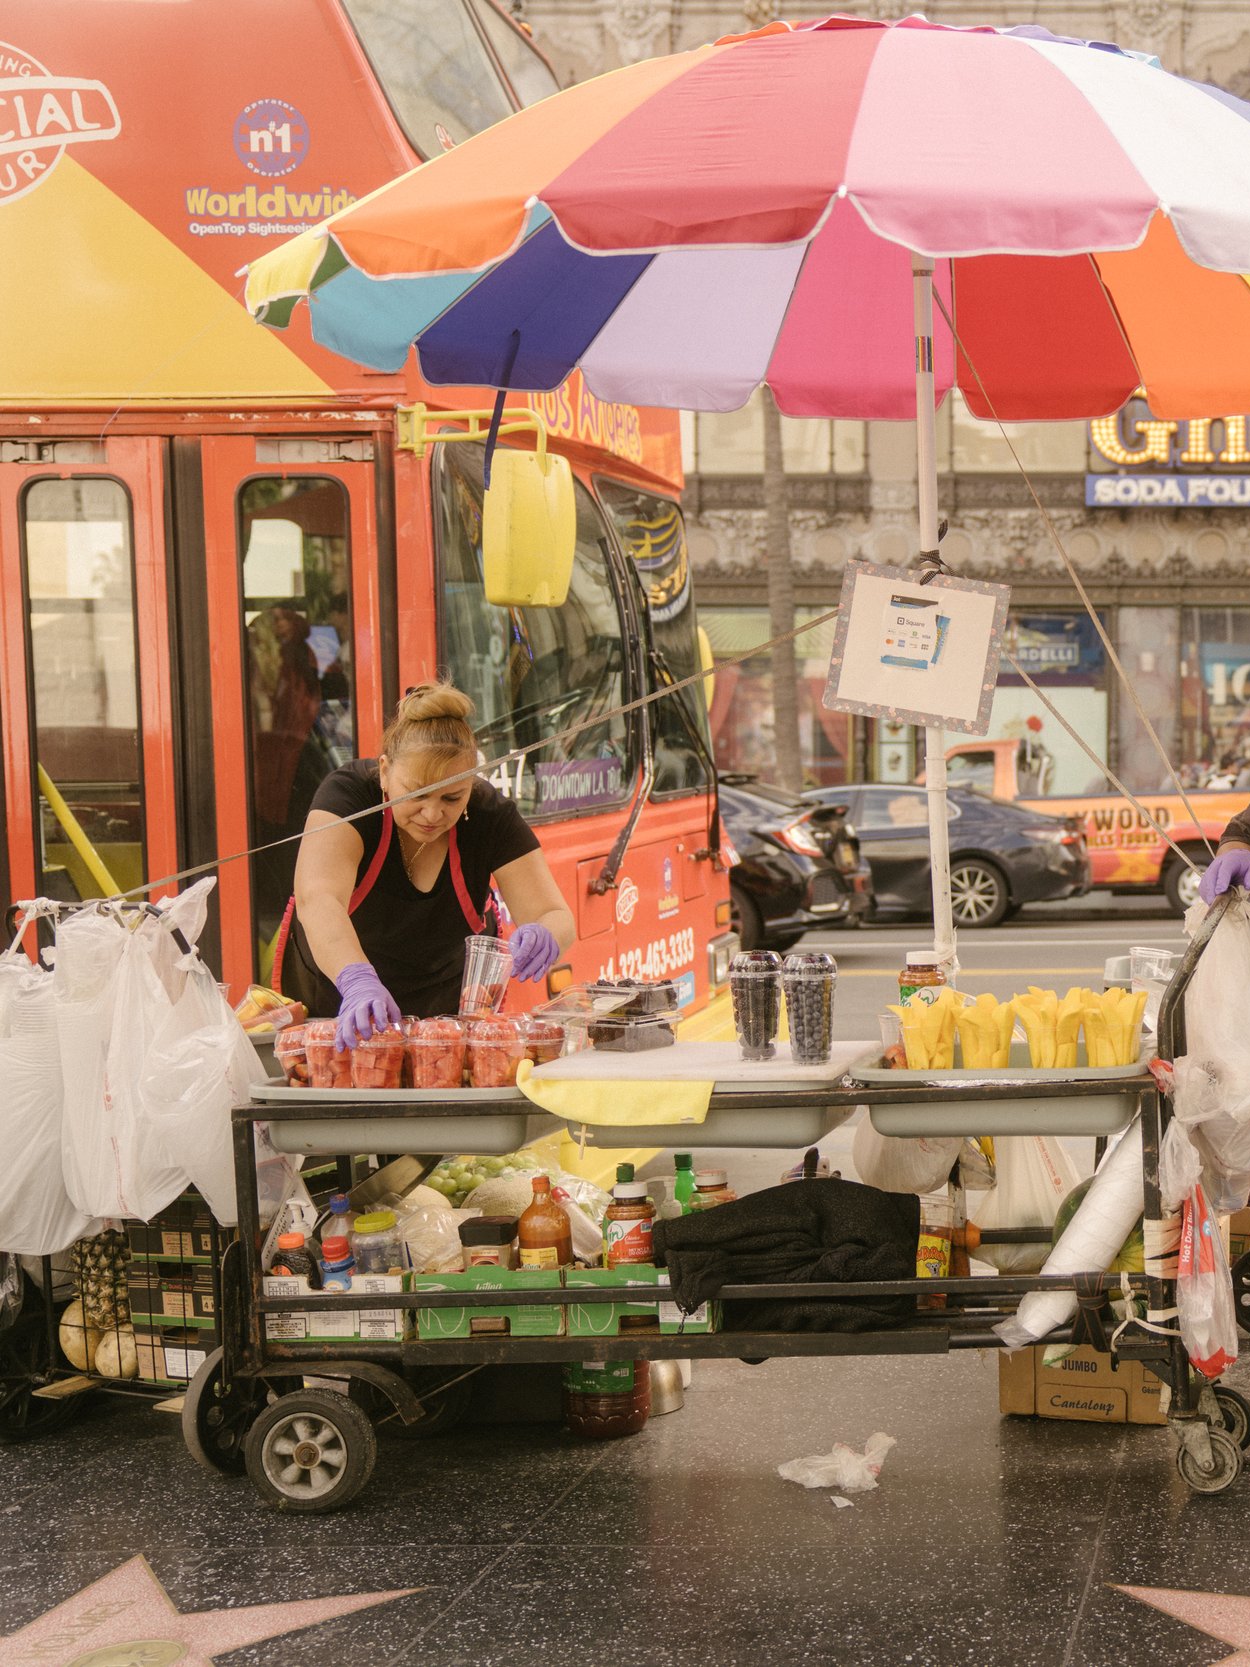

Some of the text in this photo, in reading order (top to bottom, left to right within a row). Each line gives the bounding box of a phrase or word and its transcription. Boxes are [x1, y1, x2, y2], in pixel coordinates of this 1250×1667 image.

[1093, 478, 1184, 505] SODA
[1061, 1359, 1098, 1373] JUMBO
[1050, 1394, 1115, 1416] Cantaloup
